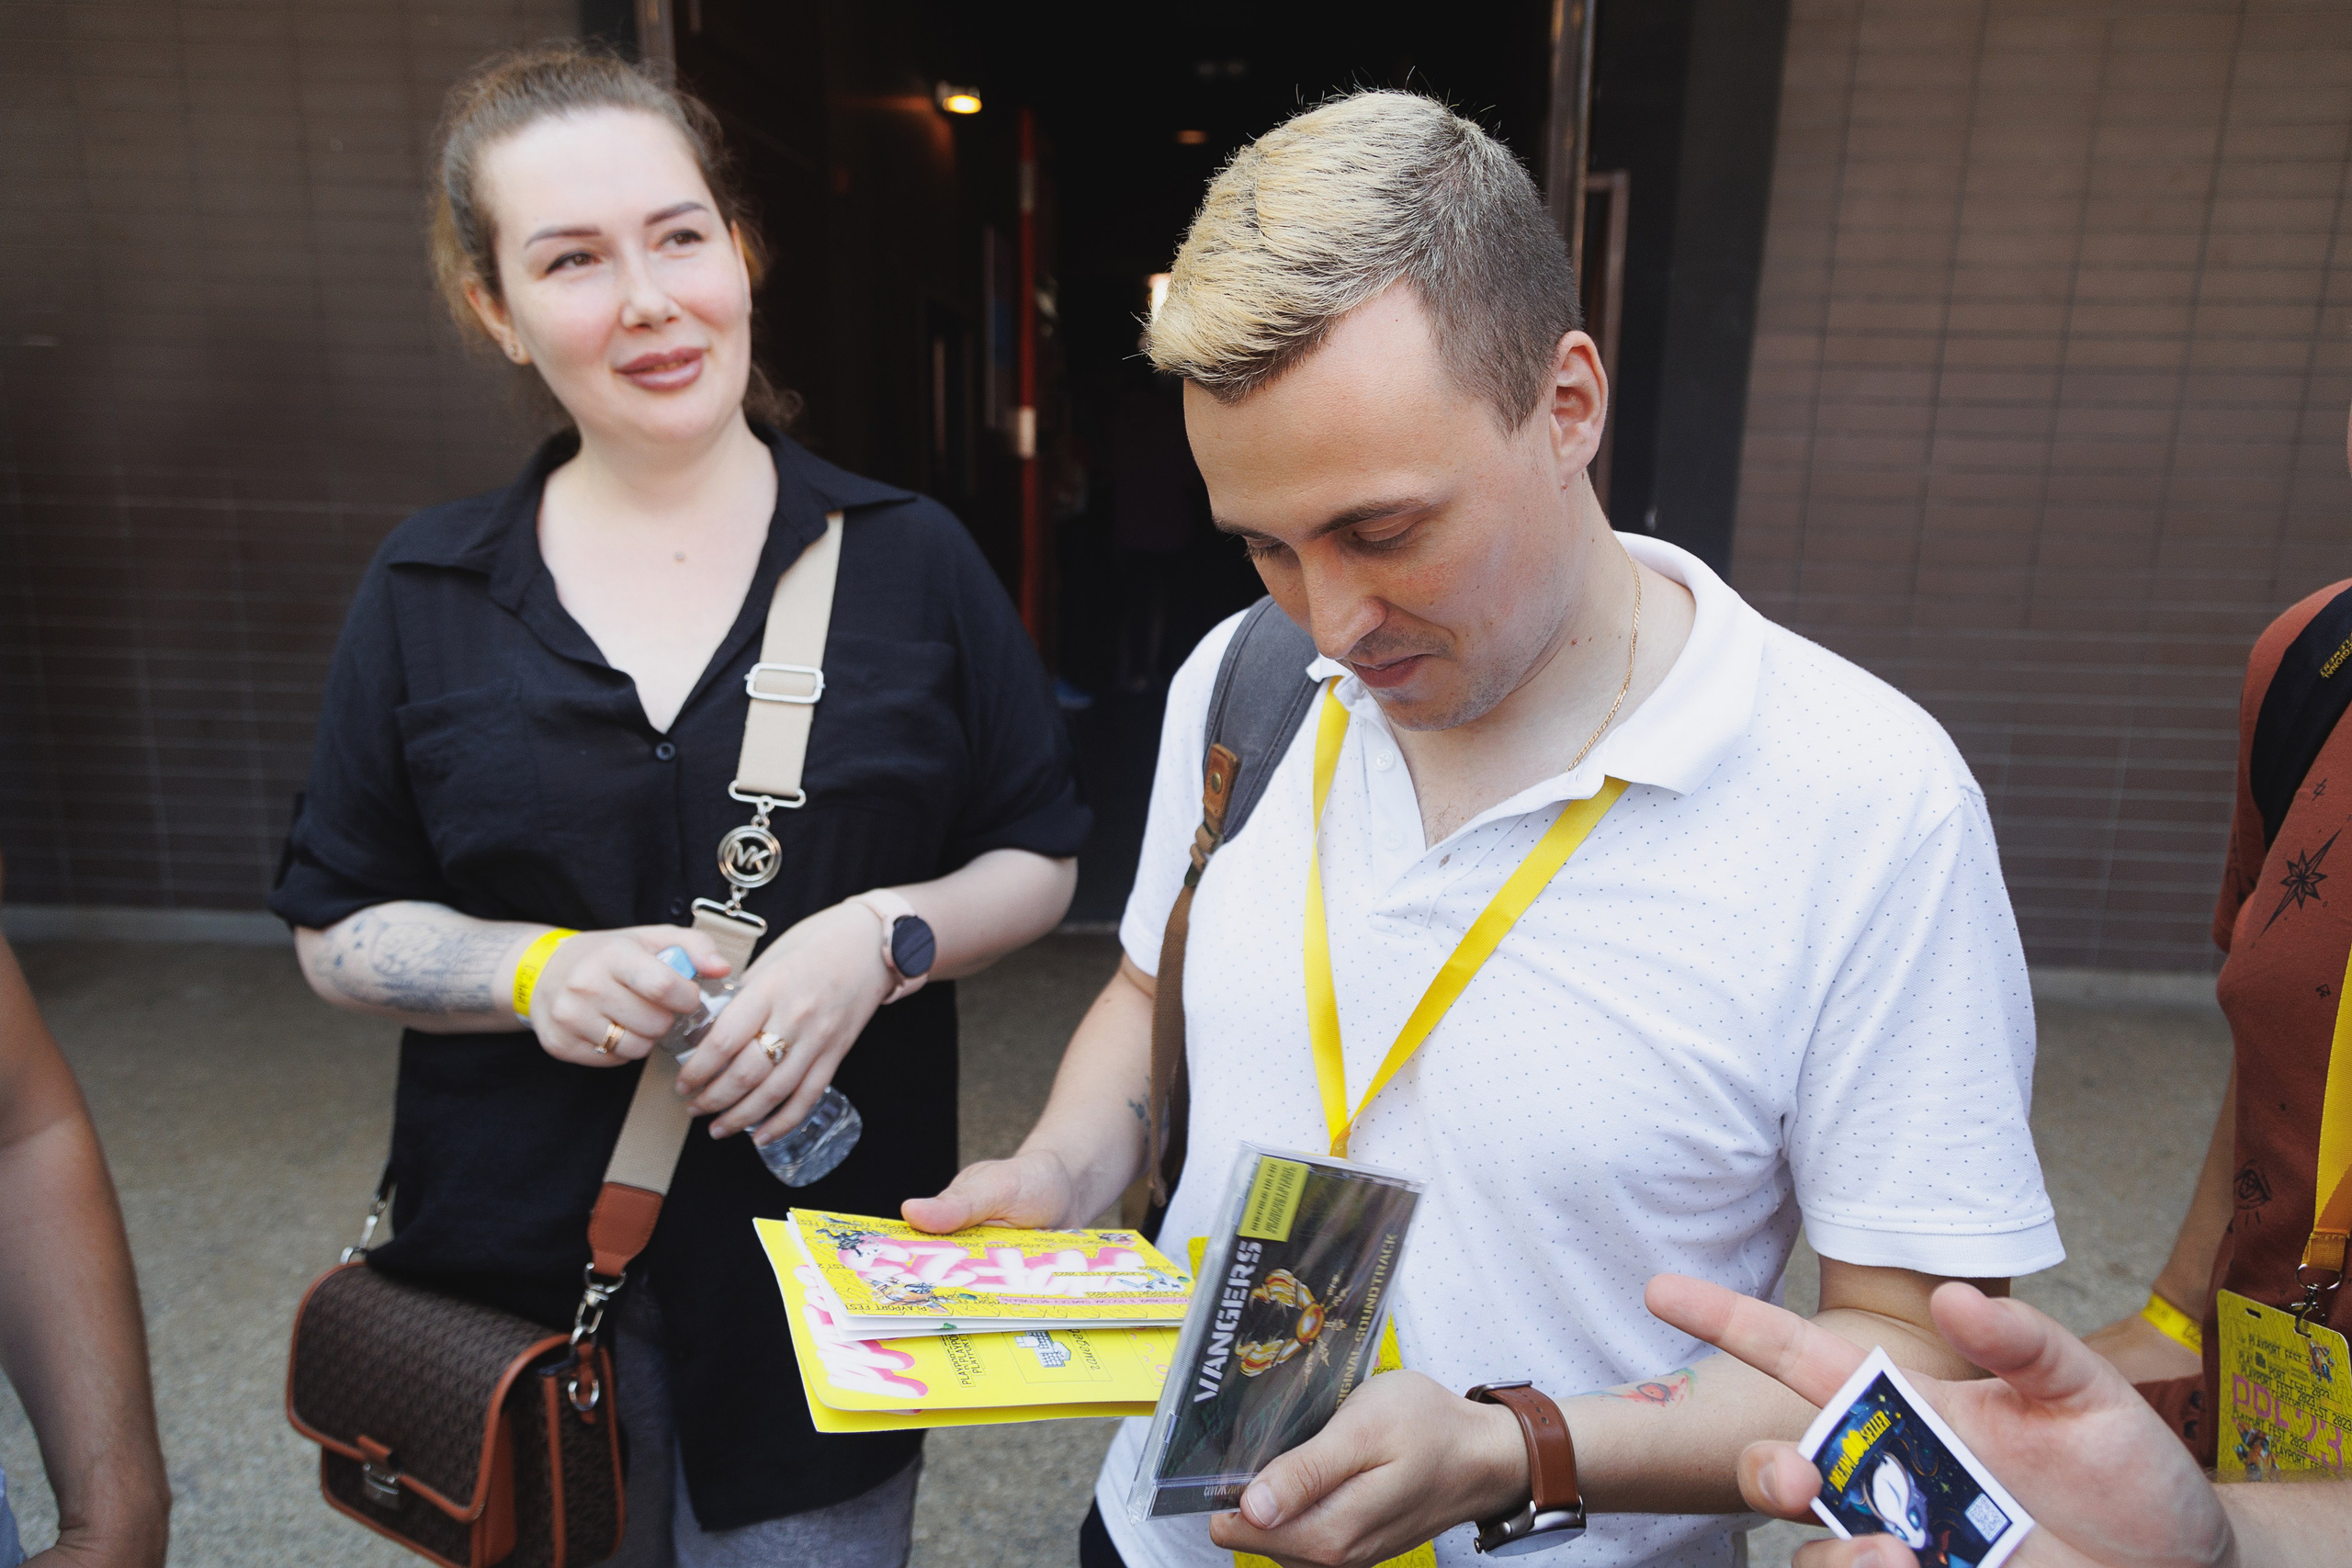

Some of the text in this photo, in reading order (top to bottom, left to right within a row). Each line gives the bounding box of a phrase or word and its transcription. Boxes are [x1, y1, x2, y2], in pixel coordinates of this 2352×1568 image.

[726, 840, 771, 872] MK
[875, 1303, 927, 1312] PLAYPORT
[1193, 1240, 1263, 1403] VANGERS
[1355, 1234, 1397, 1342] SOUNDTRACK
[1828, 1410, 1892, 1494] DREAM SELLER
